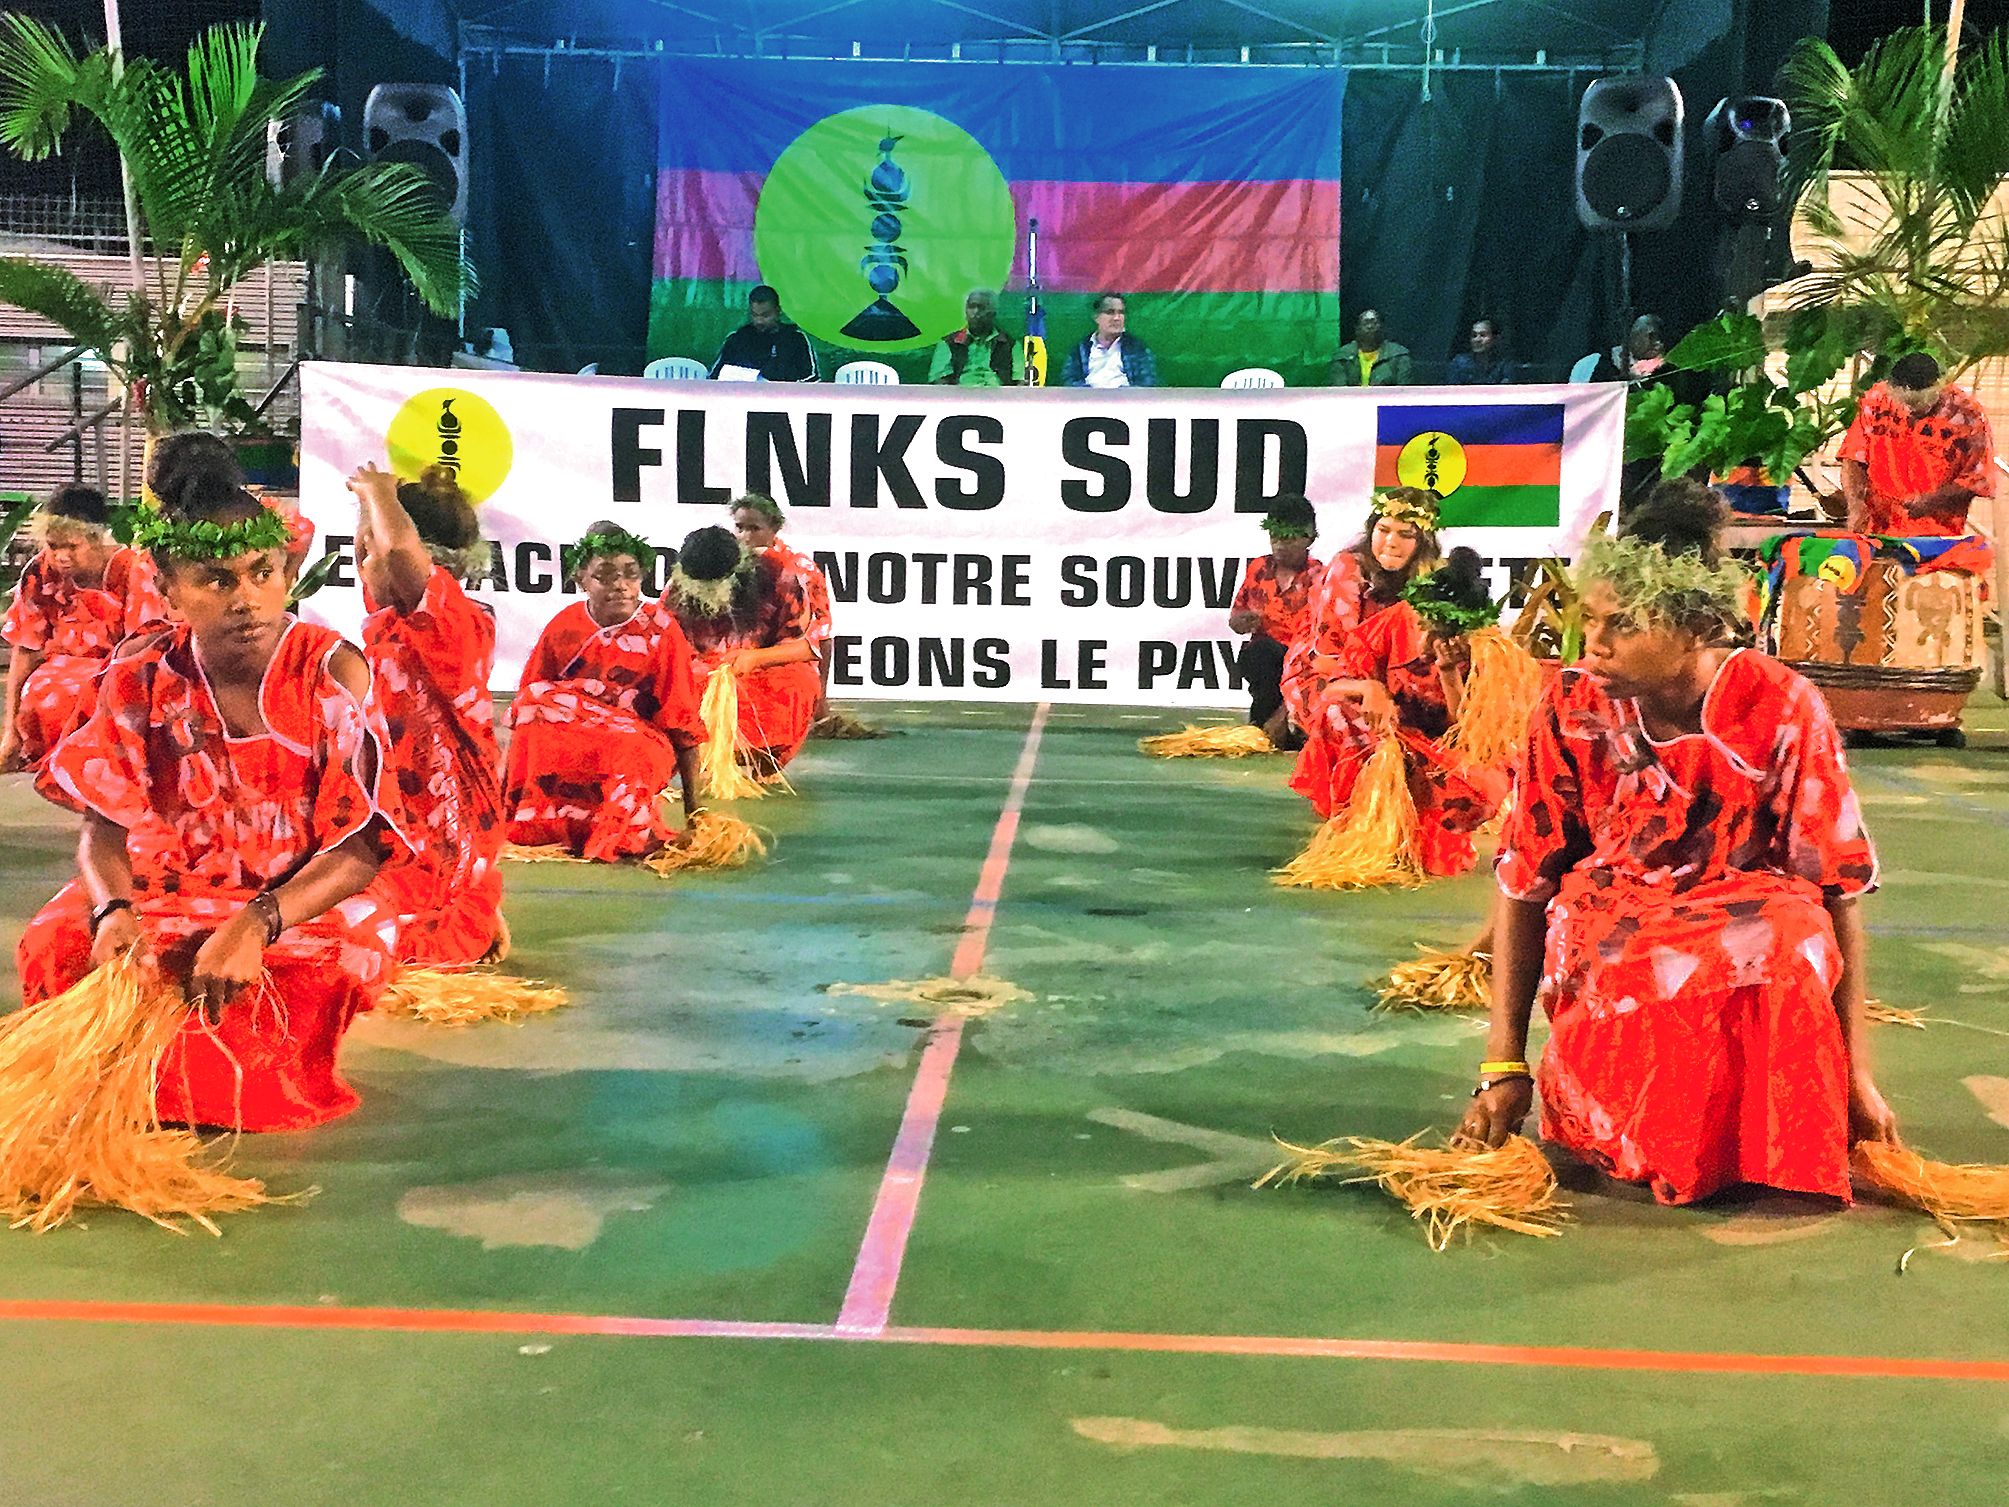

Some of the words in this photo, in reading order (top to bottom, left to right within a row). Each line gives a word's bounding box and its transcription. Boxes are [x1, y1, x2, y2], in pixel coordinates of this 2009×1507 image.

[611, 408, 1006, 511] FLNKS
[1060, 415, 1309, 513] SUD
[813, 551, 1031, 606] NOTRE
[1041, 639, 1107, 689] LE
[1138, 640, 1251, 690] PAY
